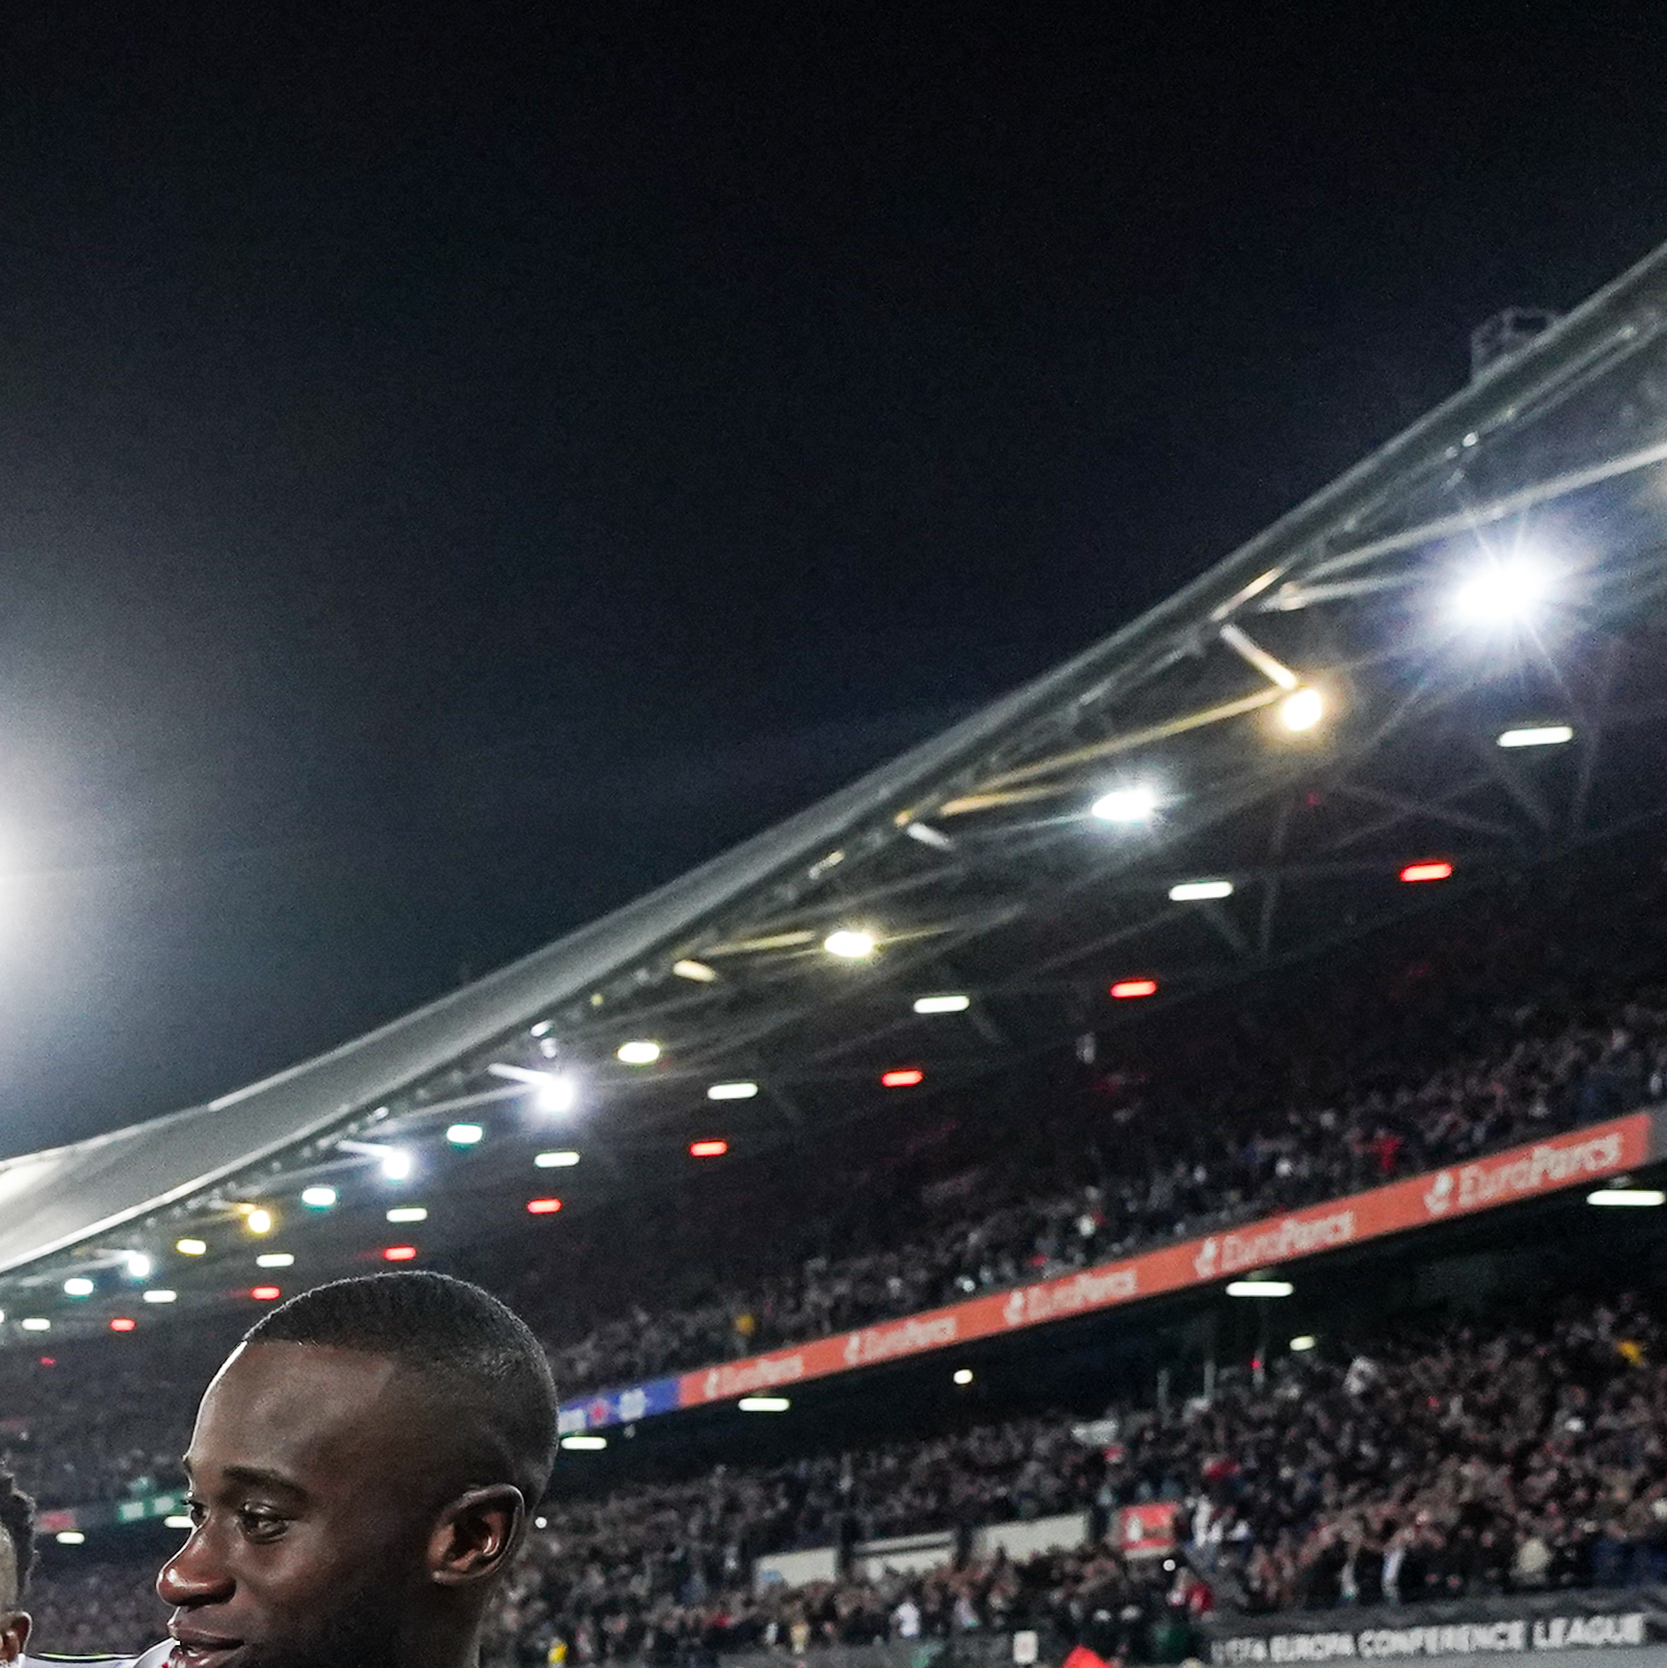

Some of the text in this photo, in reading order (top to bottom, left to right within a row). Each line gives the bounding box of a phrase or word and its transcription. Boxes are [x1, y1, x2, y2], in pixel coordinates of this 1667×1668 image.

[1270, 1632, 1354, 1662] EUROPA
[1357, 1620, 1526, 1657] CONFERENCE
[1532, 1613, 1646, 1649] LEAGUE
